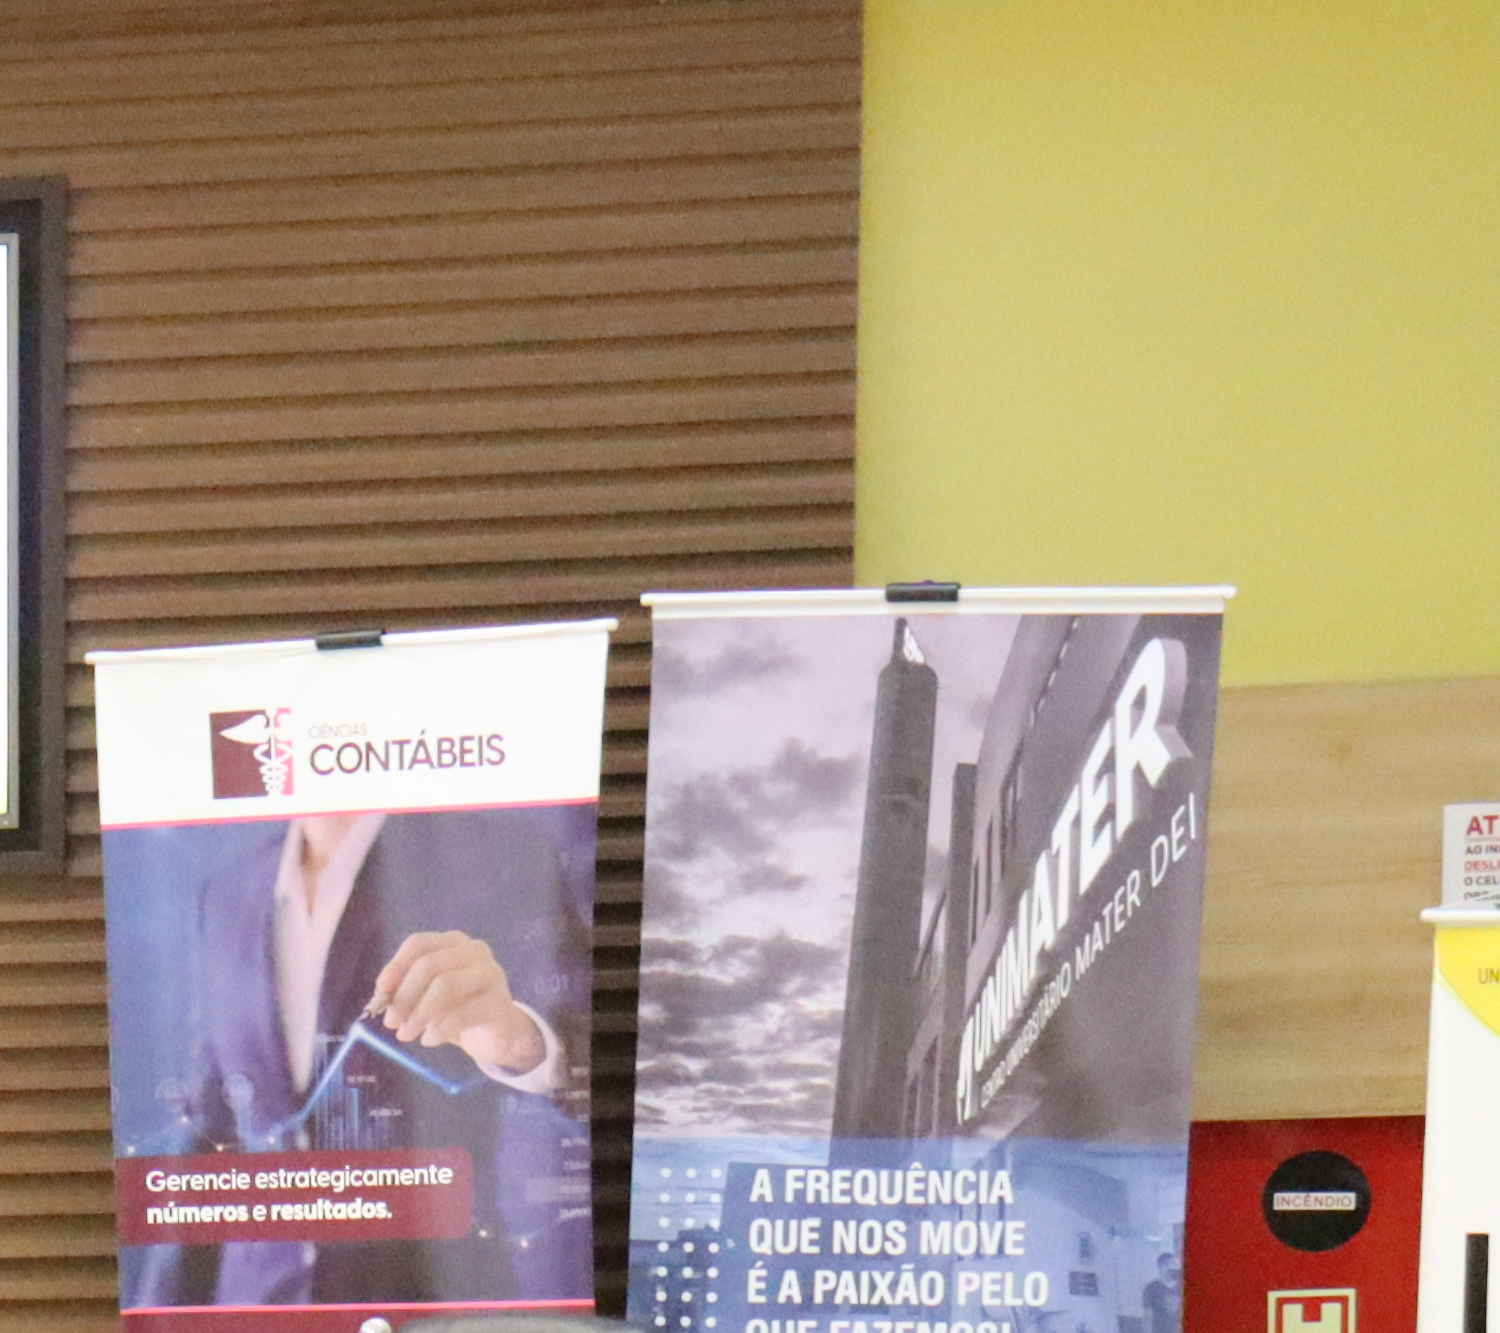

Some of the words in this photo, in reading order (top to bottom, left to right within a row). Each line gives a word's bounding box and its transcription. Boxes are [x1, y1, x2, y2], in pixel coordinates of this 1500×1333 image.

[307, 721, 368, 740] CIÊNCIAS
[308, 729, 506, 776] CONTÁBEIS
[973, 637, 1184, 1075] UNIMATER
[1074, 868, 1142, 981] MATER
[1149, 792, 1197, 888] DEI
[144, 1168, 252, 1193] Gerencie
[254, 1163, 454, 1194] estrategicamente
[748, 1168, 774, 1203] A
[784, 1161, 1015, 1206] FREQUÊNCIA
[145, 1200, 250, 1225] números
[251, 1204, 268, 1222] e
[269, 1197, 394, 1222] resultados.
[1276, 1192, 1352, 1208] INCÊNDIO
[748, 1217, 823, 1256] QUE
[832, 1219, 908, 1256] NOS
[919, 1220, 1026, 1256] MOVE
[747, 1261, 769, 1304] É
[777, 1269, 803, 1304] A
[813, 1263, 946, 1307] PAIXÃO
[956, 1271, 1050, 1307] PELO
